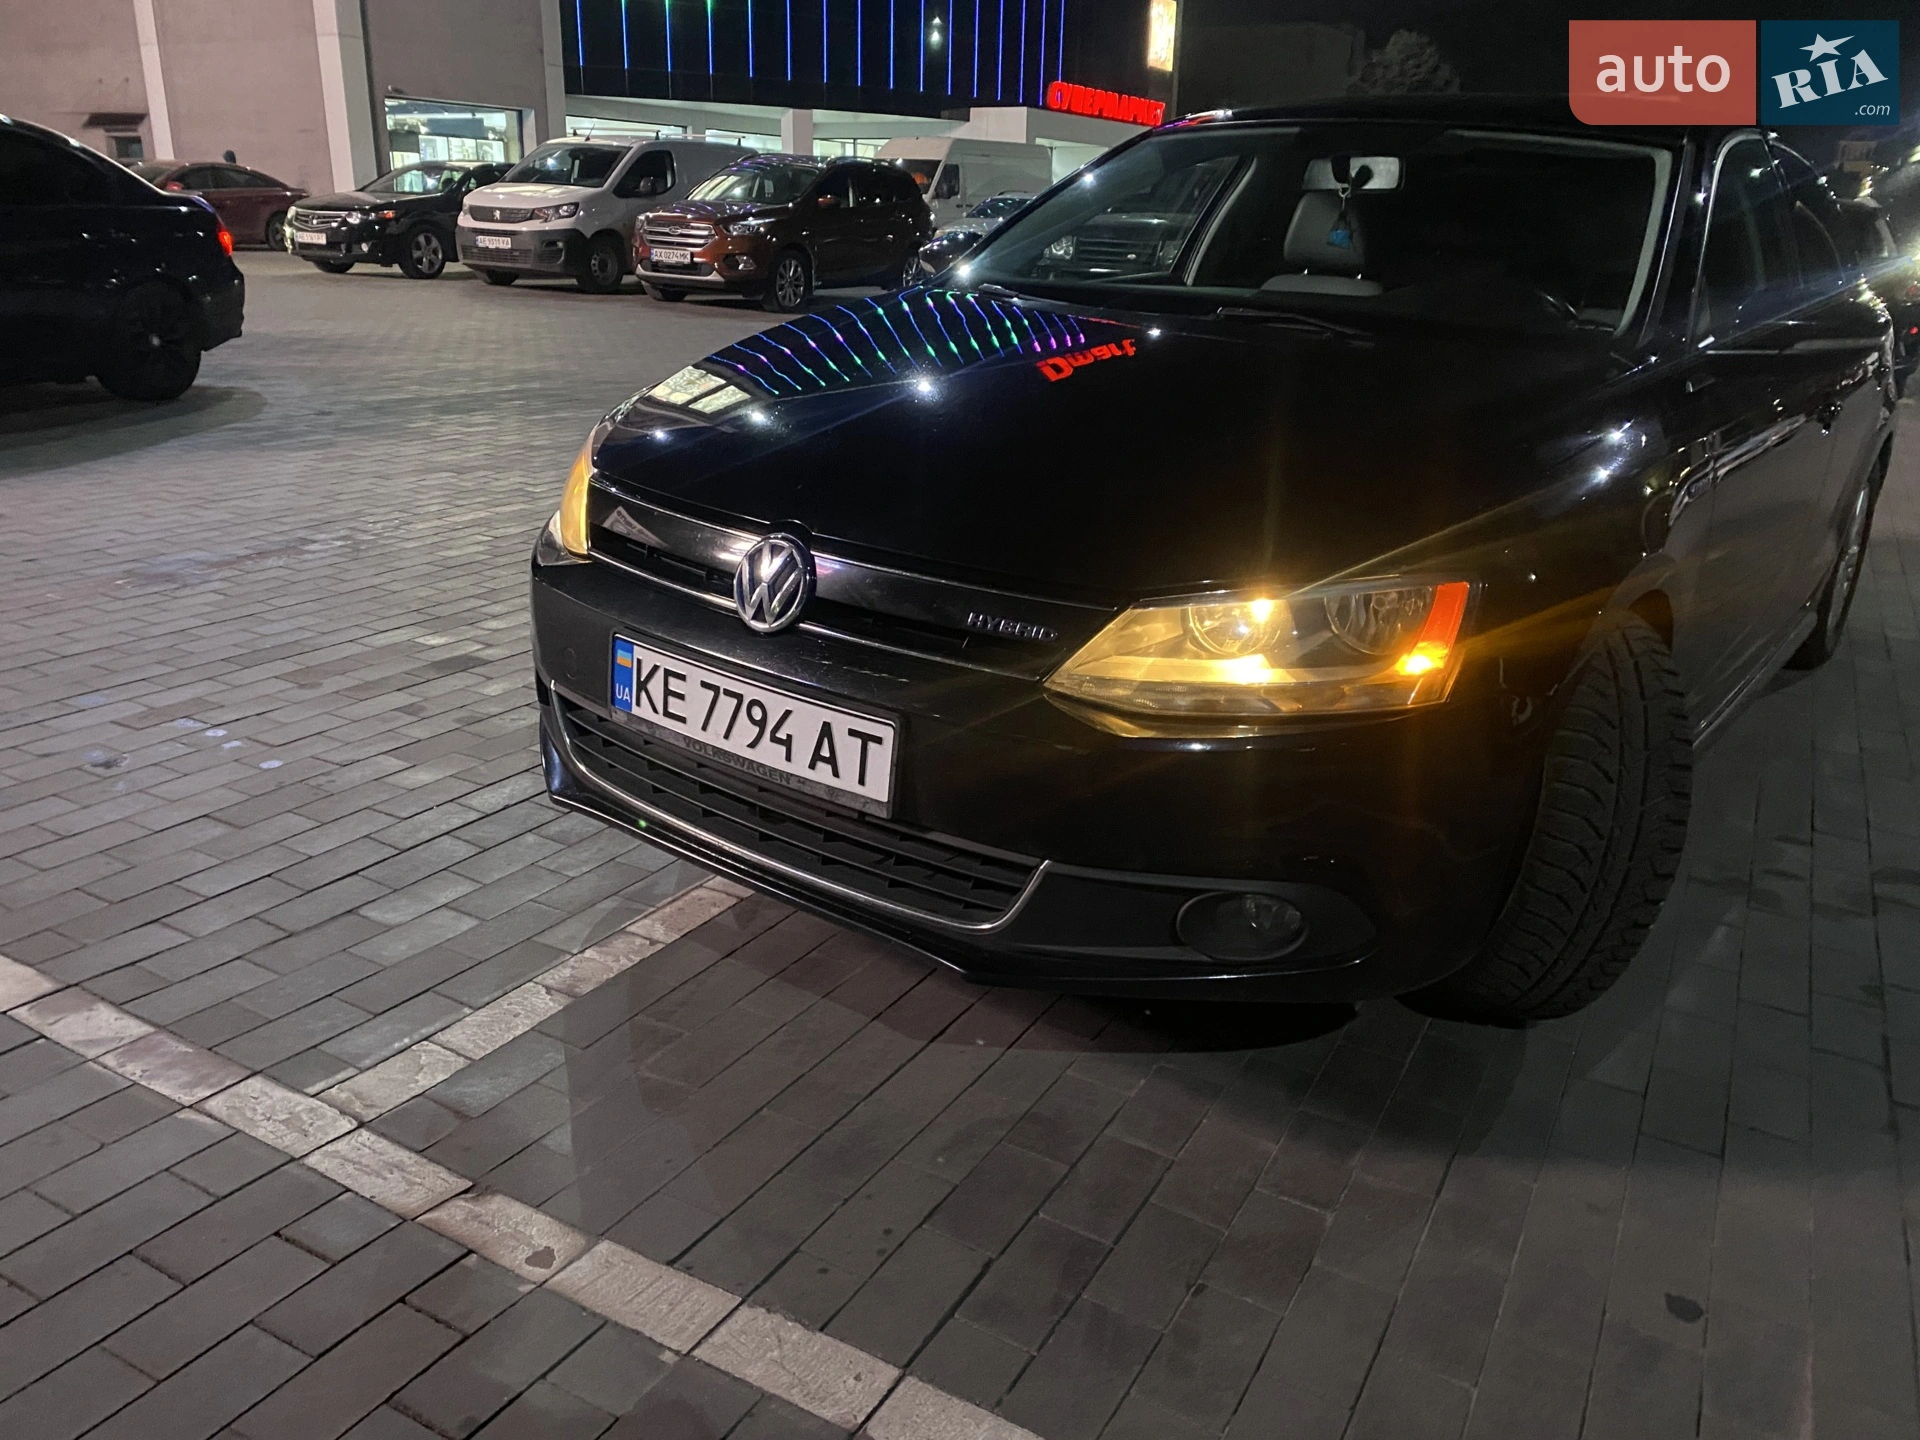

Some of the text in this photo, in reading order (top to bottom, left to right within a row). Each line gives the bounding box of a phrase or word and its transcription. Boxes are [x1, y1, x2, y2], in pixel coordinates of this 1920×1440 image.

[654, 250, 663, 259] AX
[663, 251, 679, 260] 0274
[967, 612, 1058, 640] HYBRID
[615, 683, 631, 703] UA
[635, 657, 883, 787] KE 7794 AT
[683, 737, 792, 785] VOLKSWAGEN
